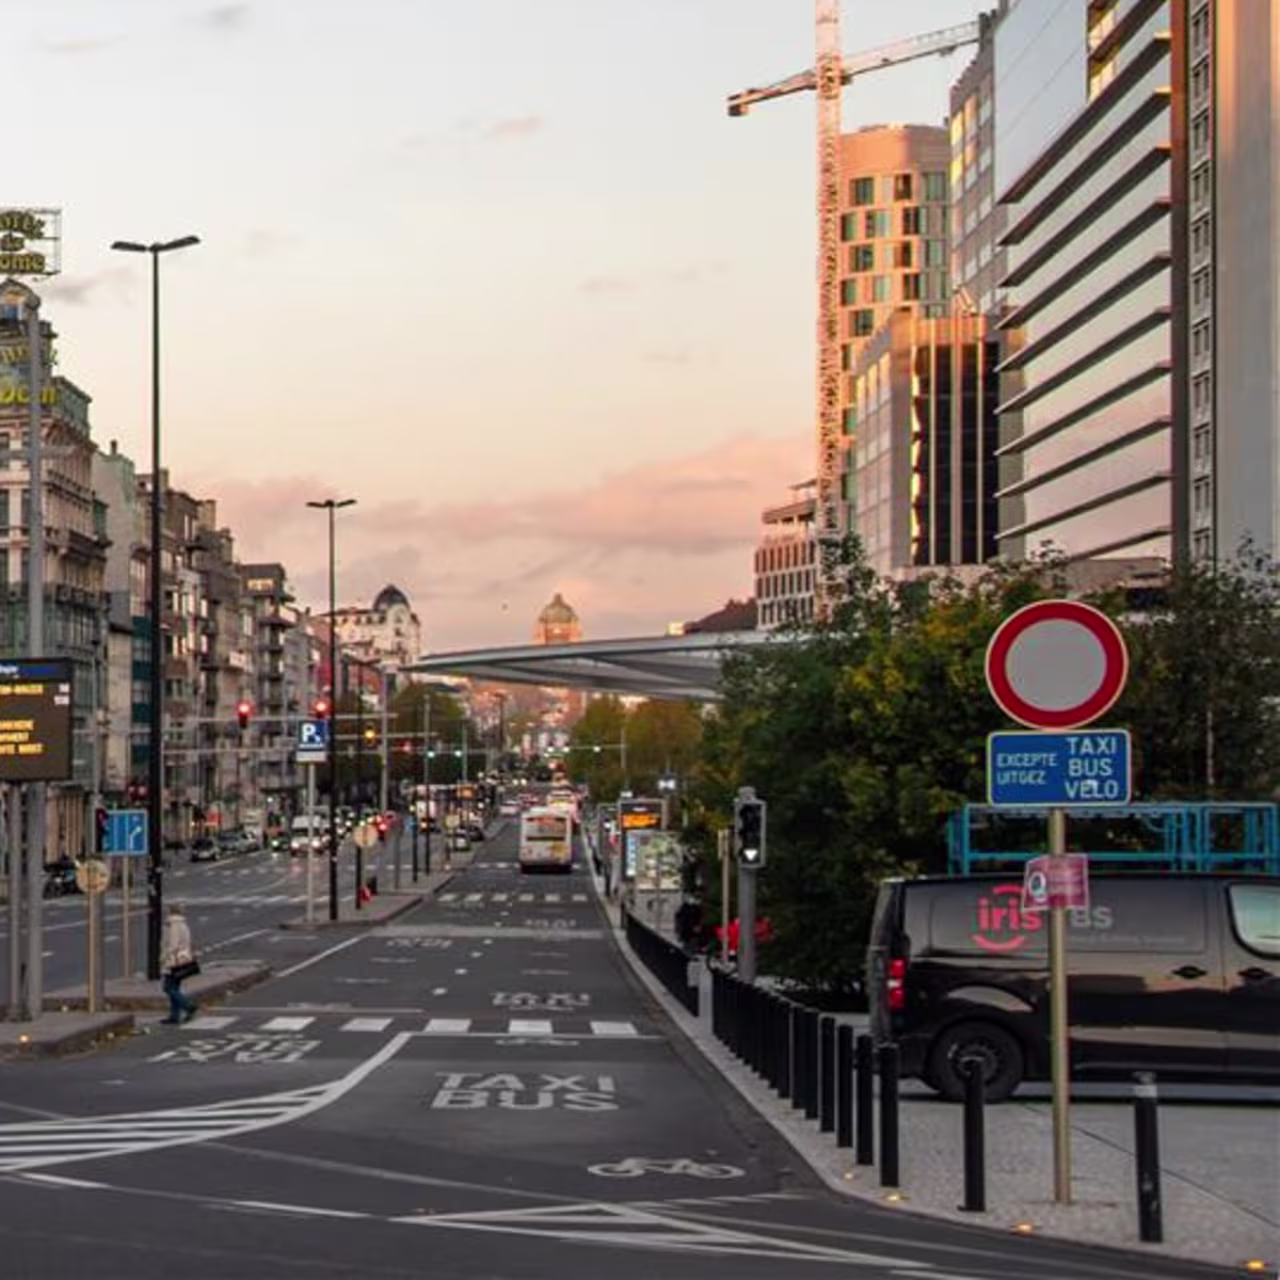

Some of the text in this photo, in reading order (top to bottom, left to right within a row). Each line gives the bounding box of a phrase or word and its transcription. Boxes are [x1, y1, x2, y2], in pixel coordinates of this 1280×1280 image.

[1065, 736, 1118, 756] TAXI
[1068, 757, 1113, 778] BUS
[979, 897, 1044, 931] iris
[434, 1072, 616, 1091] TAXI
[431, 1090, 619, 1111] BUS
